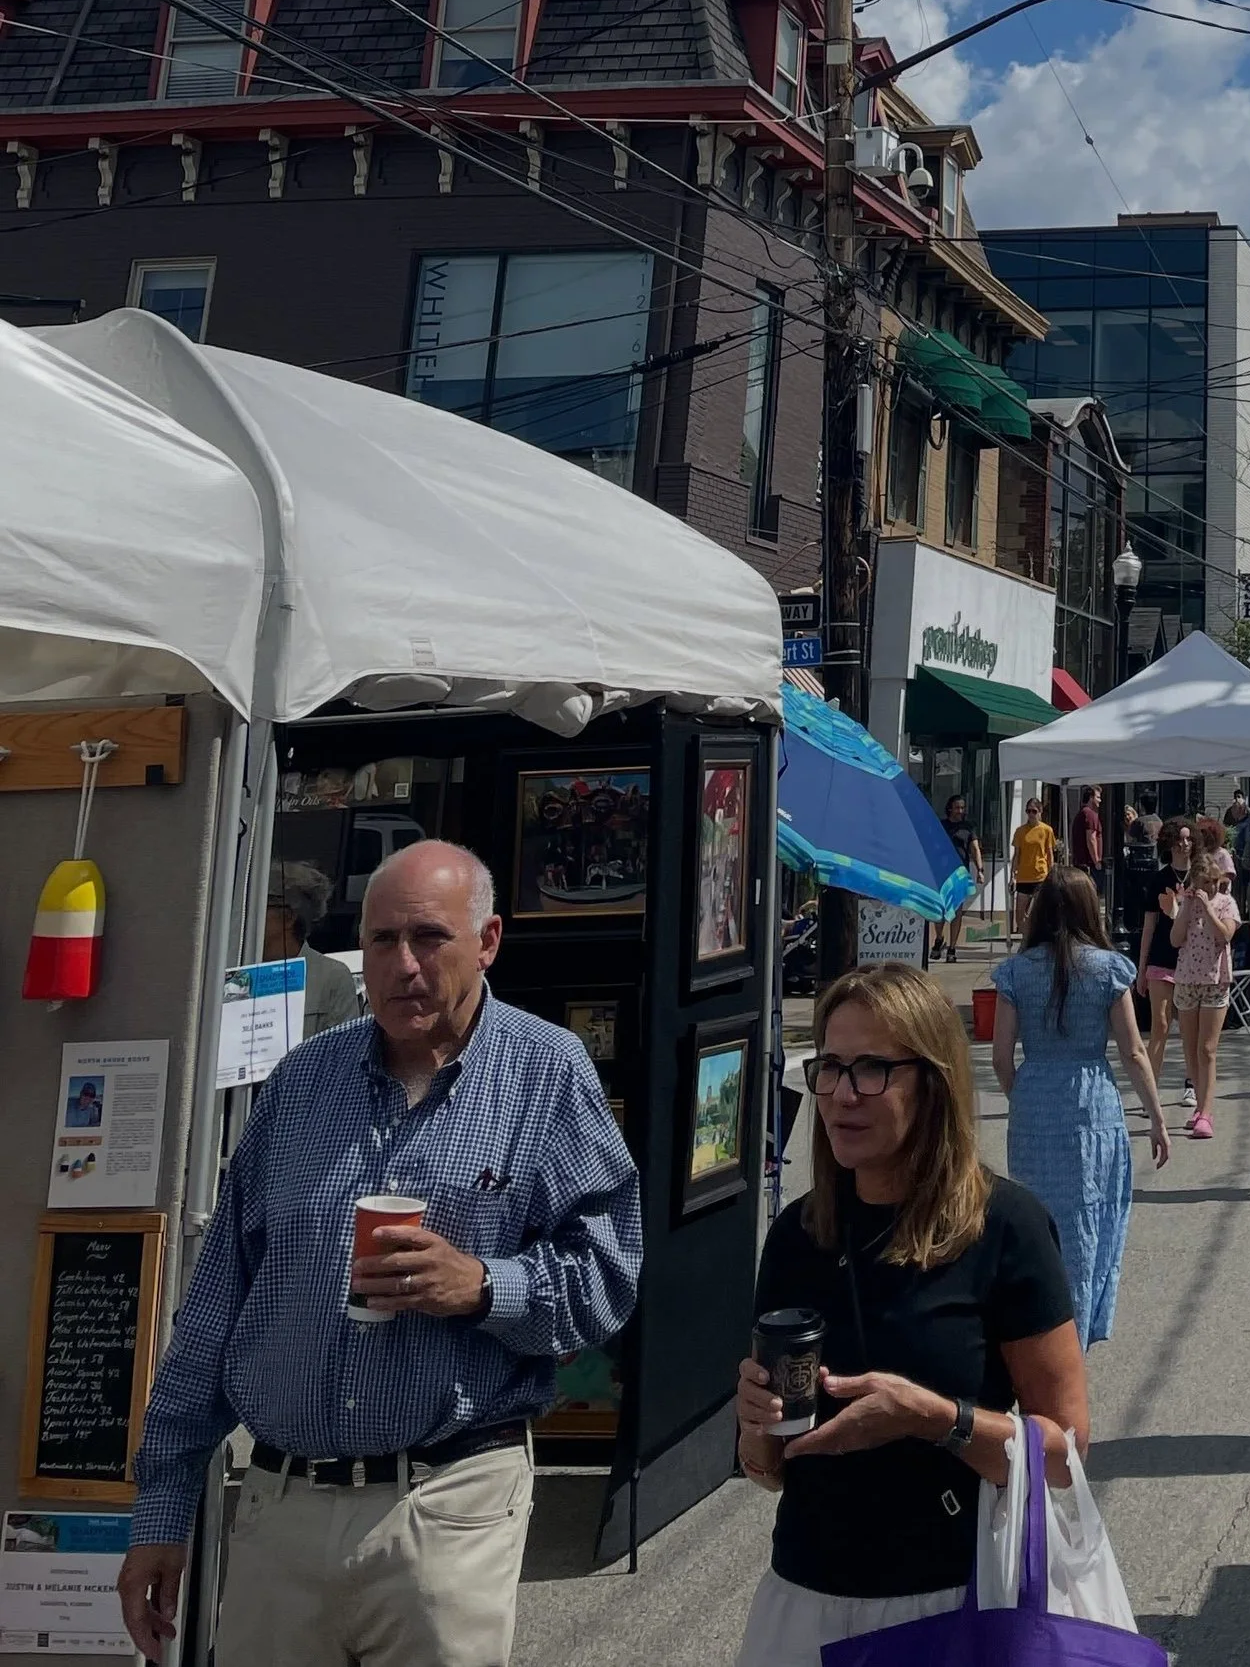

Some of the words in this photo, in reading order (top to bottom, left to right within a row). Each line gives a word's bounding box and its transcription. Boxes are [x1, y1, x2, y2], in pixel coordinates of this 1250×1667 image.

[801, 641, 815, 660] St
[862, 922, 917, 945] Scribe
[859, 951, 917, 959] STATIONERY
